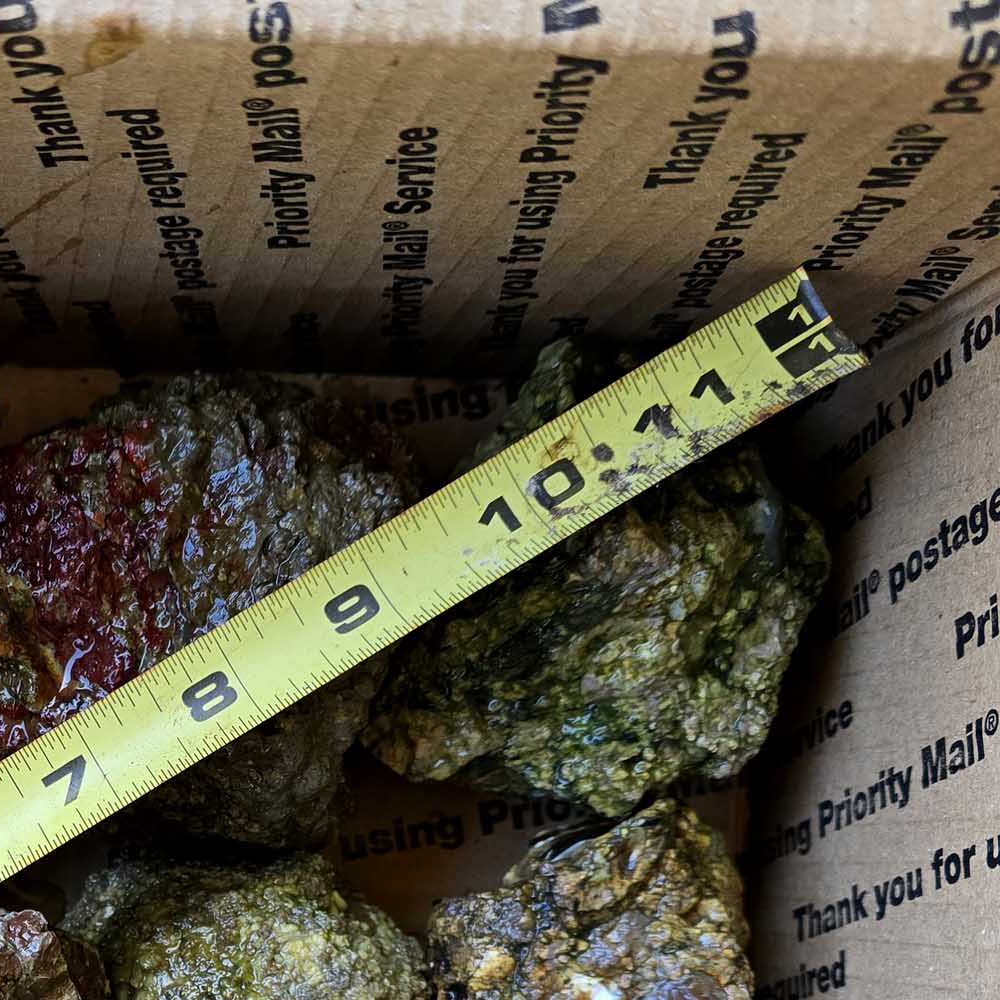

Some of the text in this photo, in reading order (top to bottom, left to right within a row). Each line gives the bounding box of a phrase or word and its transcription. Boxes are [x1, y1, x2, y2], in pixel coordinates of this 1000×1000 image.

[11, 73, 89, 168] Thank
[241, 97, 304, 164] Mail®
[518, 54, 611, 164] Priority
[642, 11, 757, 189] Thank you
[105, 107, 187, 208] required
[383, 126, 439, 215] Service
[260, 168, 316, 249] Priority
[508, 170, 578, 231] using
[673, 131, 808, 309] postage required
[802, 195, 907, 272] Priority
[158, 216, 216, 289] postage
[497, 233, 546, 263] for
[500, 268, 538, 301] you
[899, 349, 953, 427] you
[41, 754, 86, 806] 7
[181, 670, 239, 722] 8
[323, 583, 381, 635] 9
[477, 457, 586, 533] 10
[632, 367, 737, 441] 11
[888, 486, 1000, 604] postage
[818, 764, 913, 838] Priority
[792, 844, 977, 942] Thank you for
